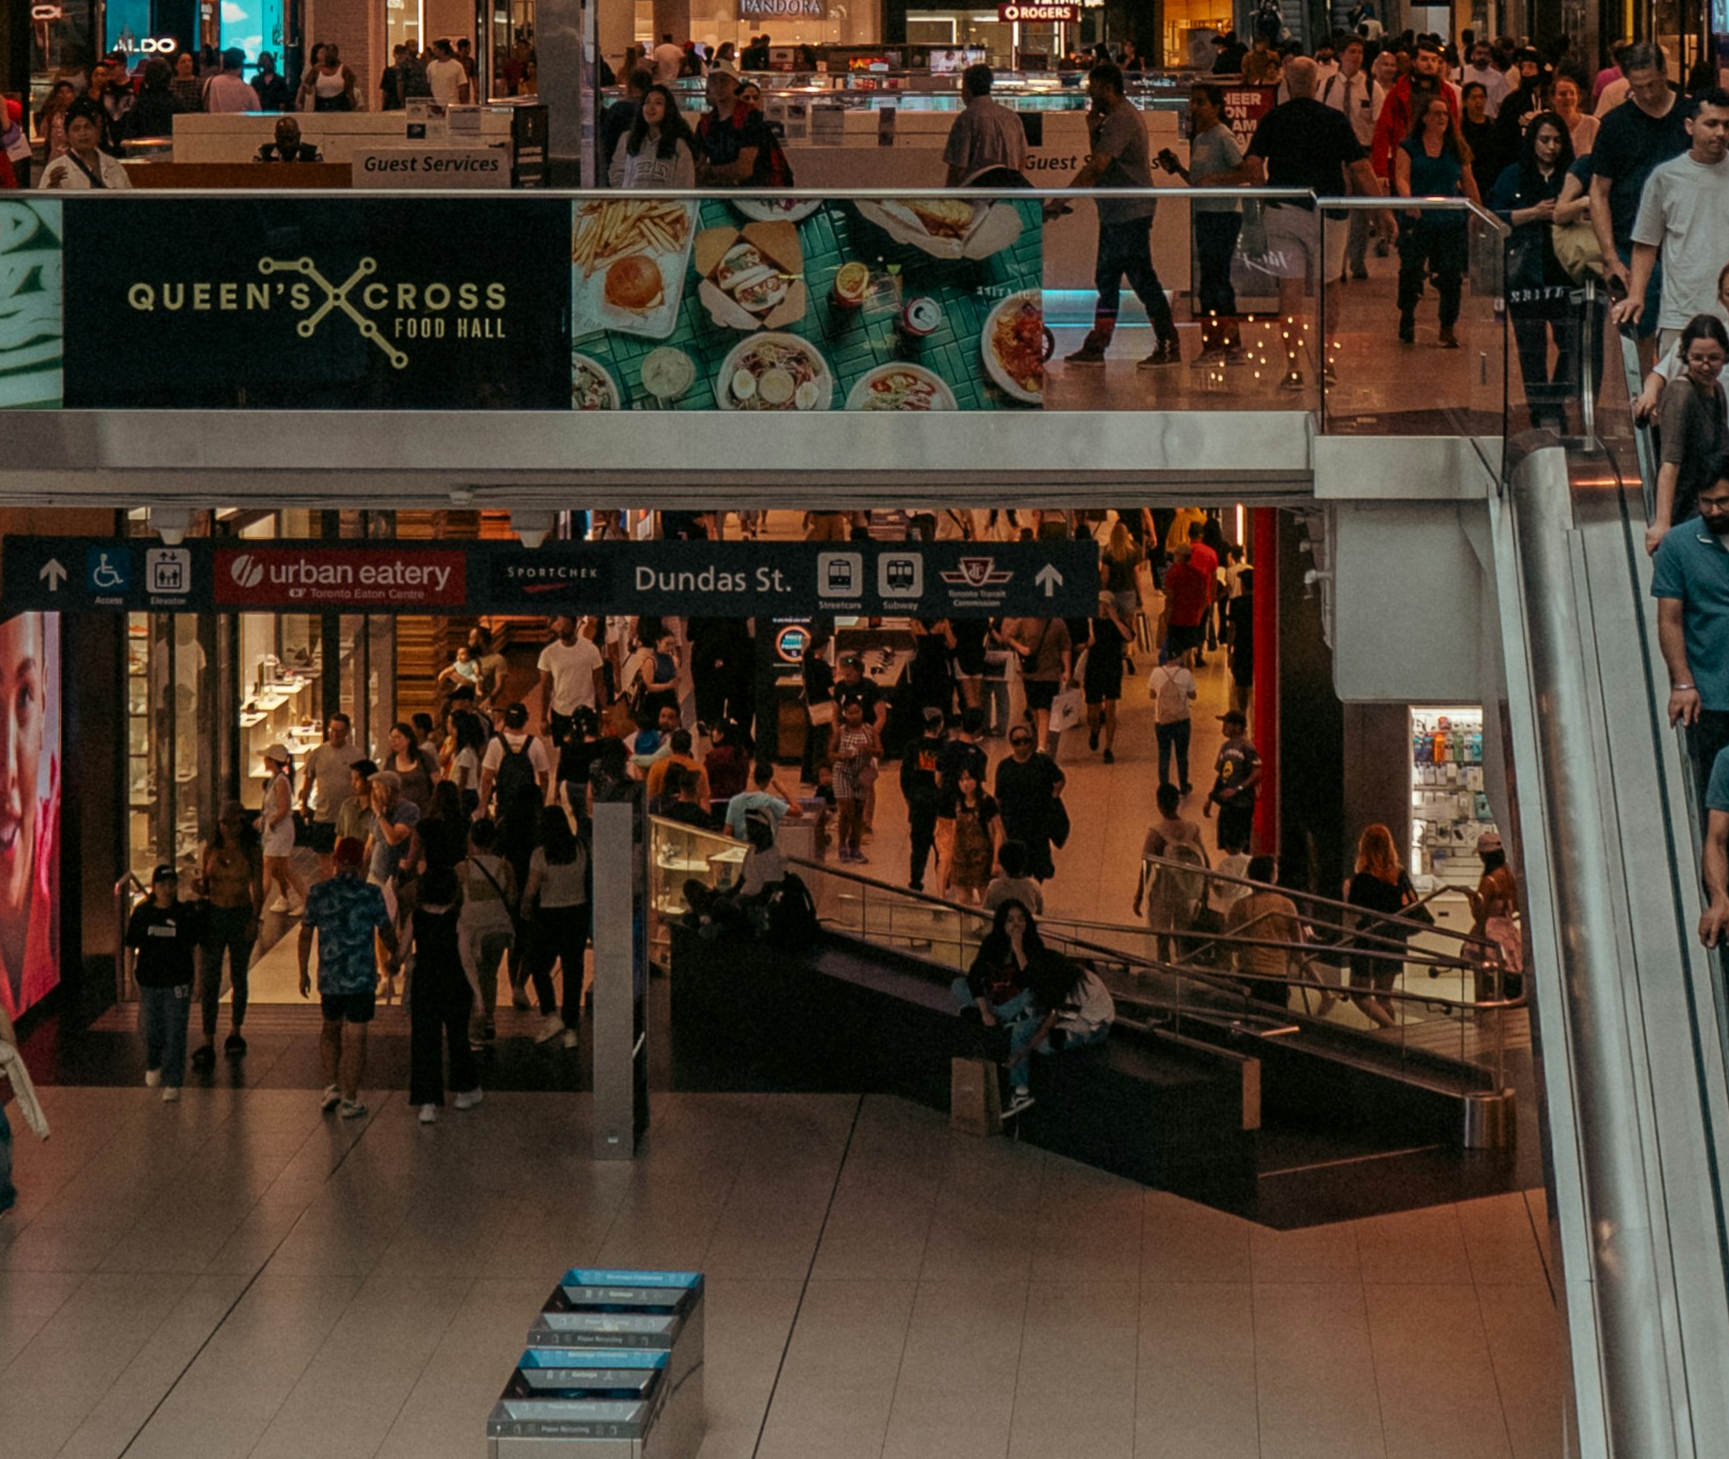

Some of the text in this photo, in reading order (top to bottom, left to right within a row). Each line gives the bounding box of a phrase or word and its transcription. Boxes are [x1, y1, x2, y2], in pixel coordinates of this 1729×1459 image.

[1020, 6, 1072, 20] ROGERS
[112, 37, 177, 54] ALDO
[1223, 92, 1262, 106] HEER
[364, 154, 500, 172] Guest Services
[1024, 154, 1078, 170] Guest
[127, 282, 507, 312] QUEEN'S CROSS
[394, 317, 507, 339] FOOD HALL
[270, 558, 452, 592] urban eatery
[635, 565, 747, 592] Dundas
[755, 566, 793, 592] St.
[94, 596, 124, 605] Access
[150, 595, 188, 606] Elevator
[311, 587, 352, 600] Toronto
[354, 588, 386, 600] Eaton
[388, 588, 425, 600] Centre
[818, 600, 863, 611] Streetcars
[882, 600, 919, 612] Subway
